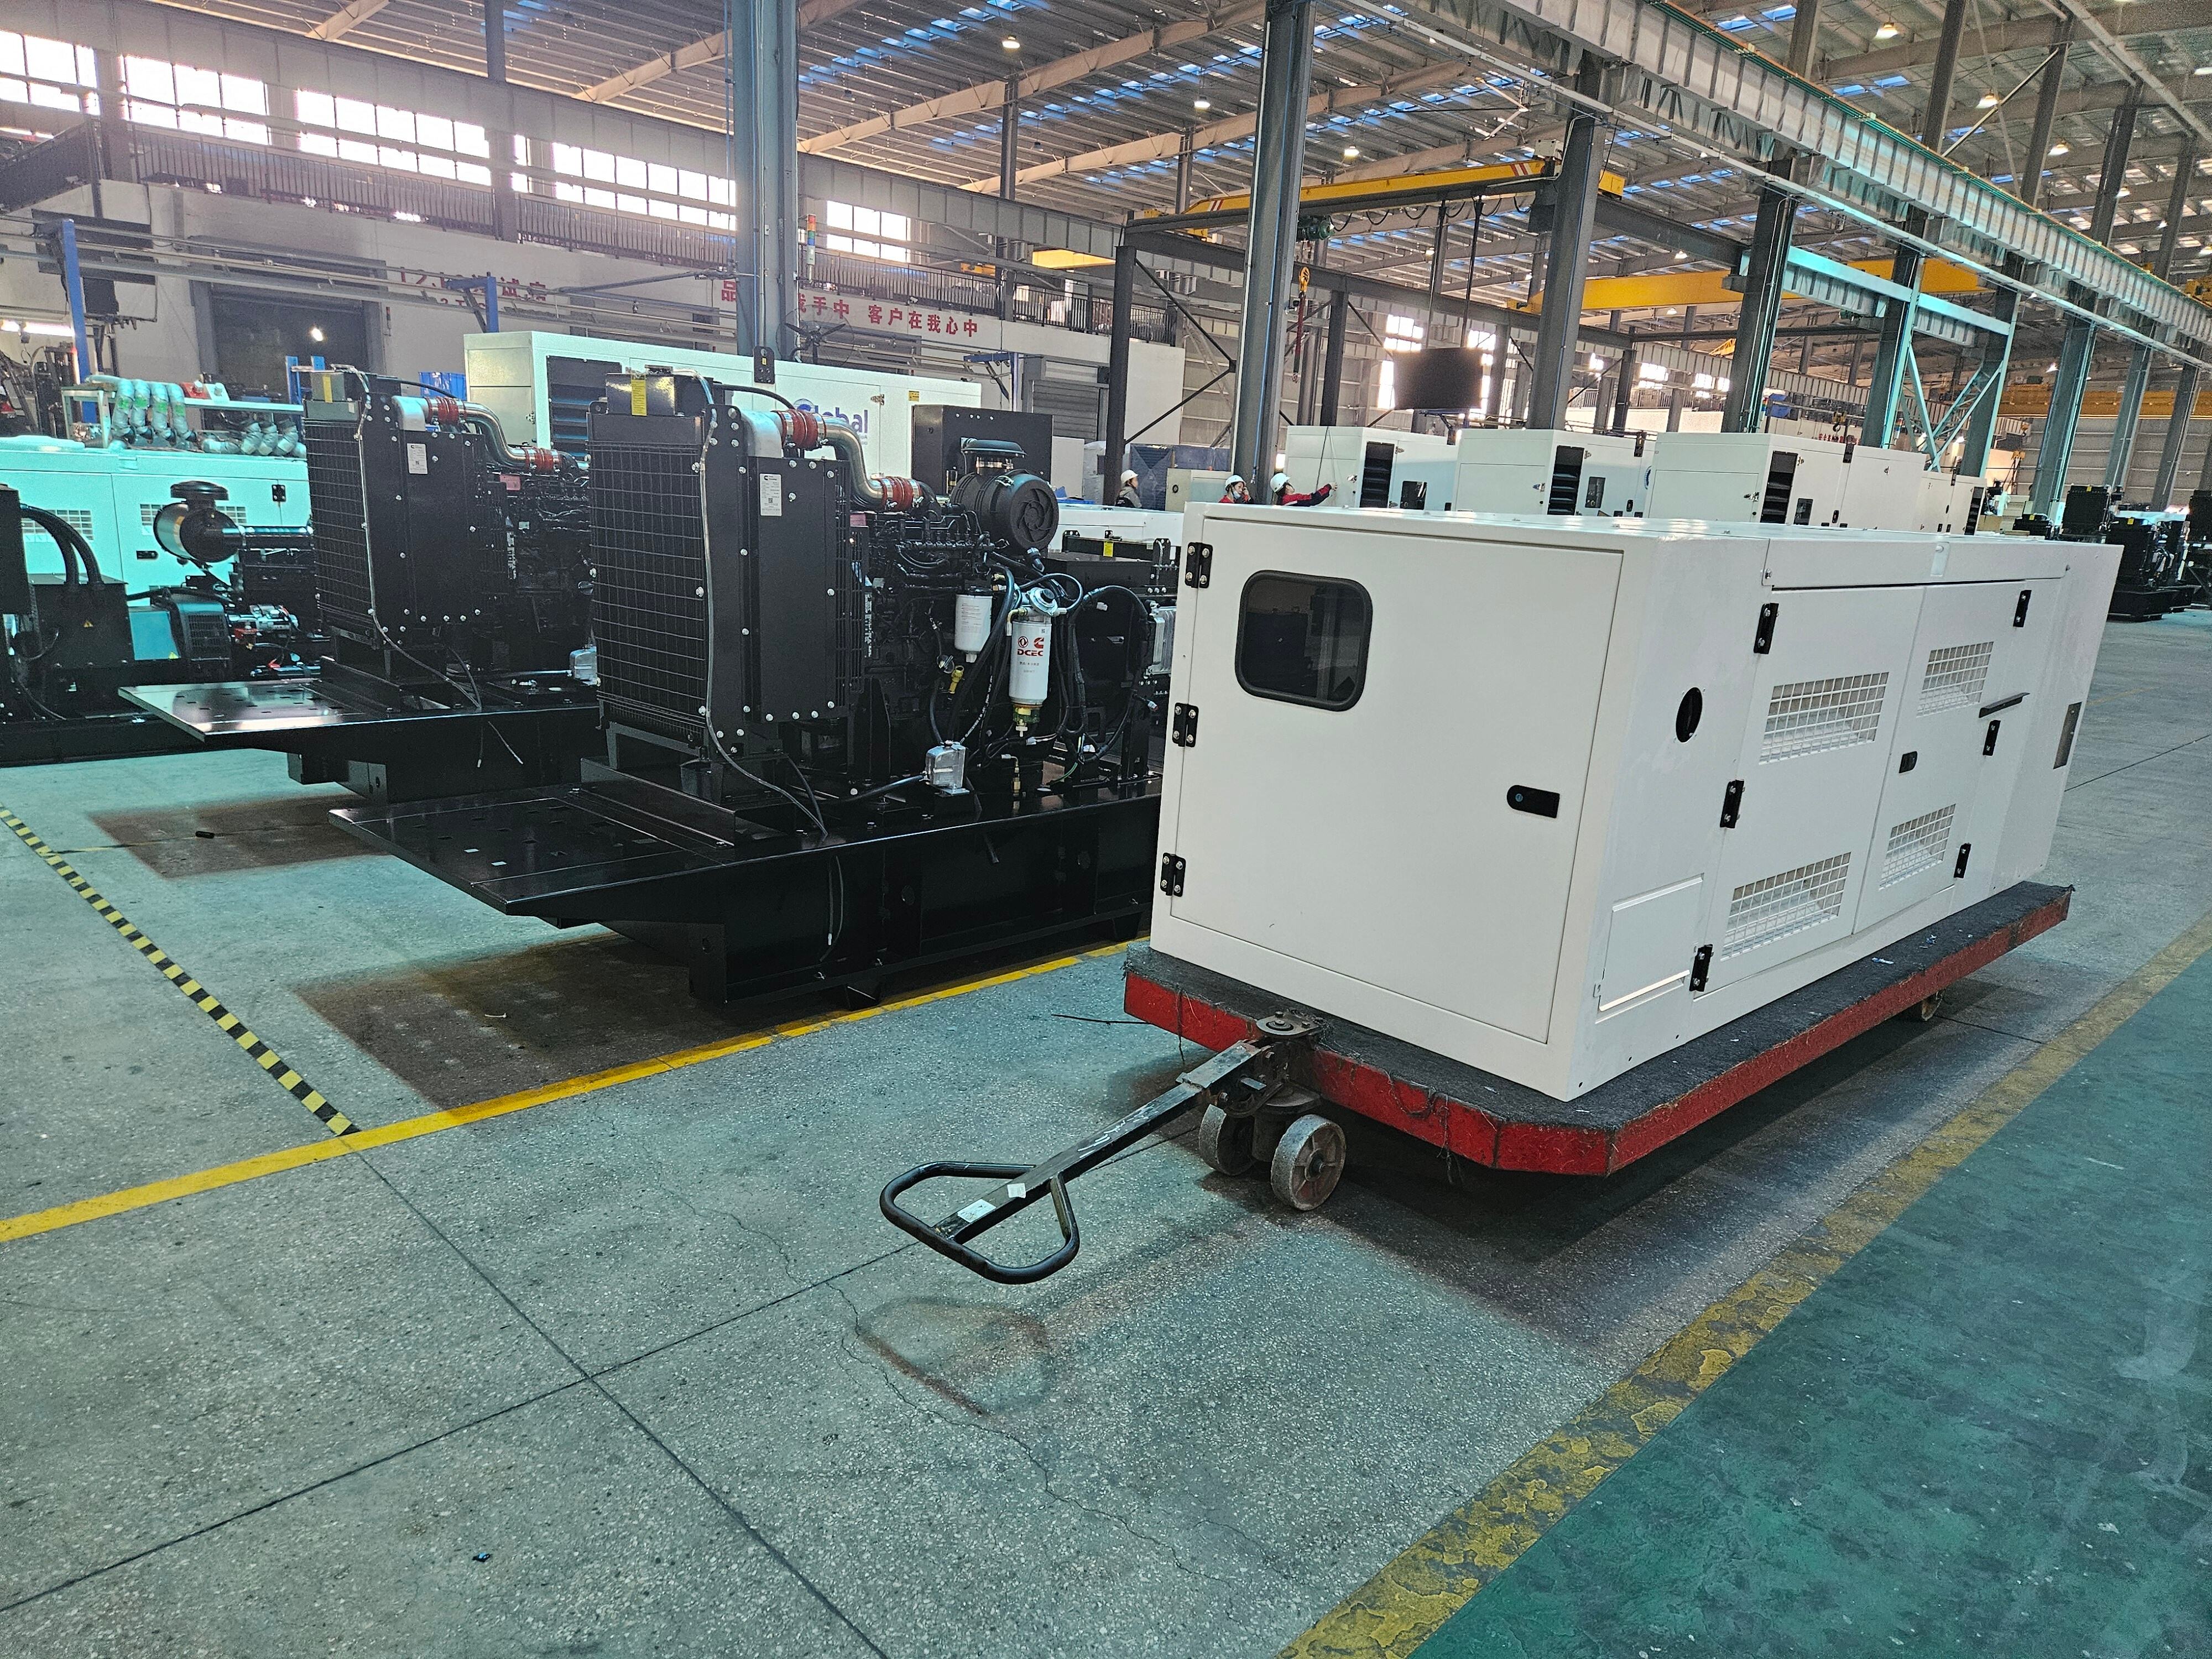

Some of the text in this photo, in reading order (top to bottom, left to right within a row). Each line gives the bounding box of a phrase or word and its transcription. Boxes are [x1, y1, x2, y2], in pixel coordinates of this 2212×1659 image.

[721, 280, 977, 337] 品手中 客户在我心中
[797, 404, 868, 433] bal
